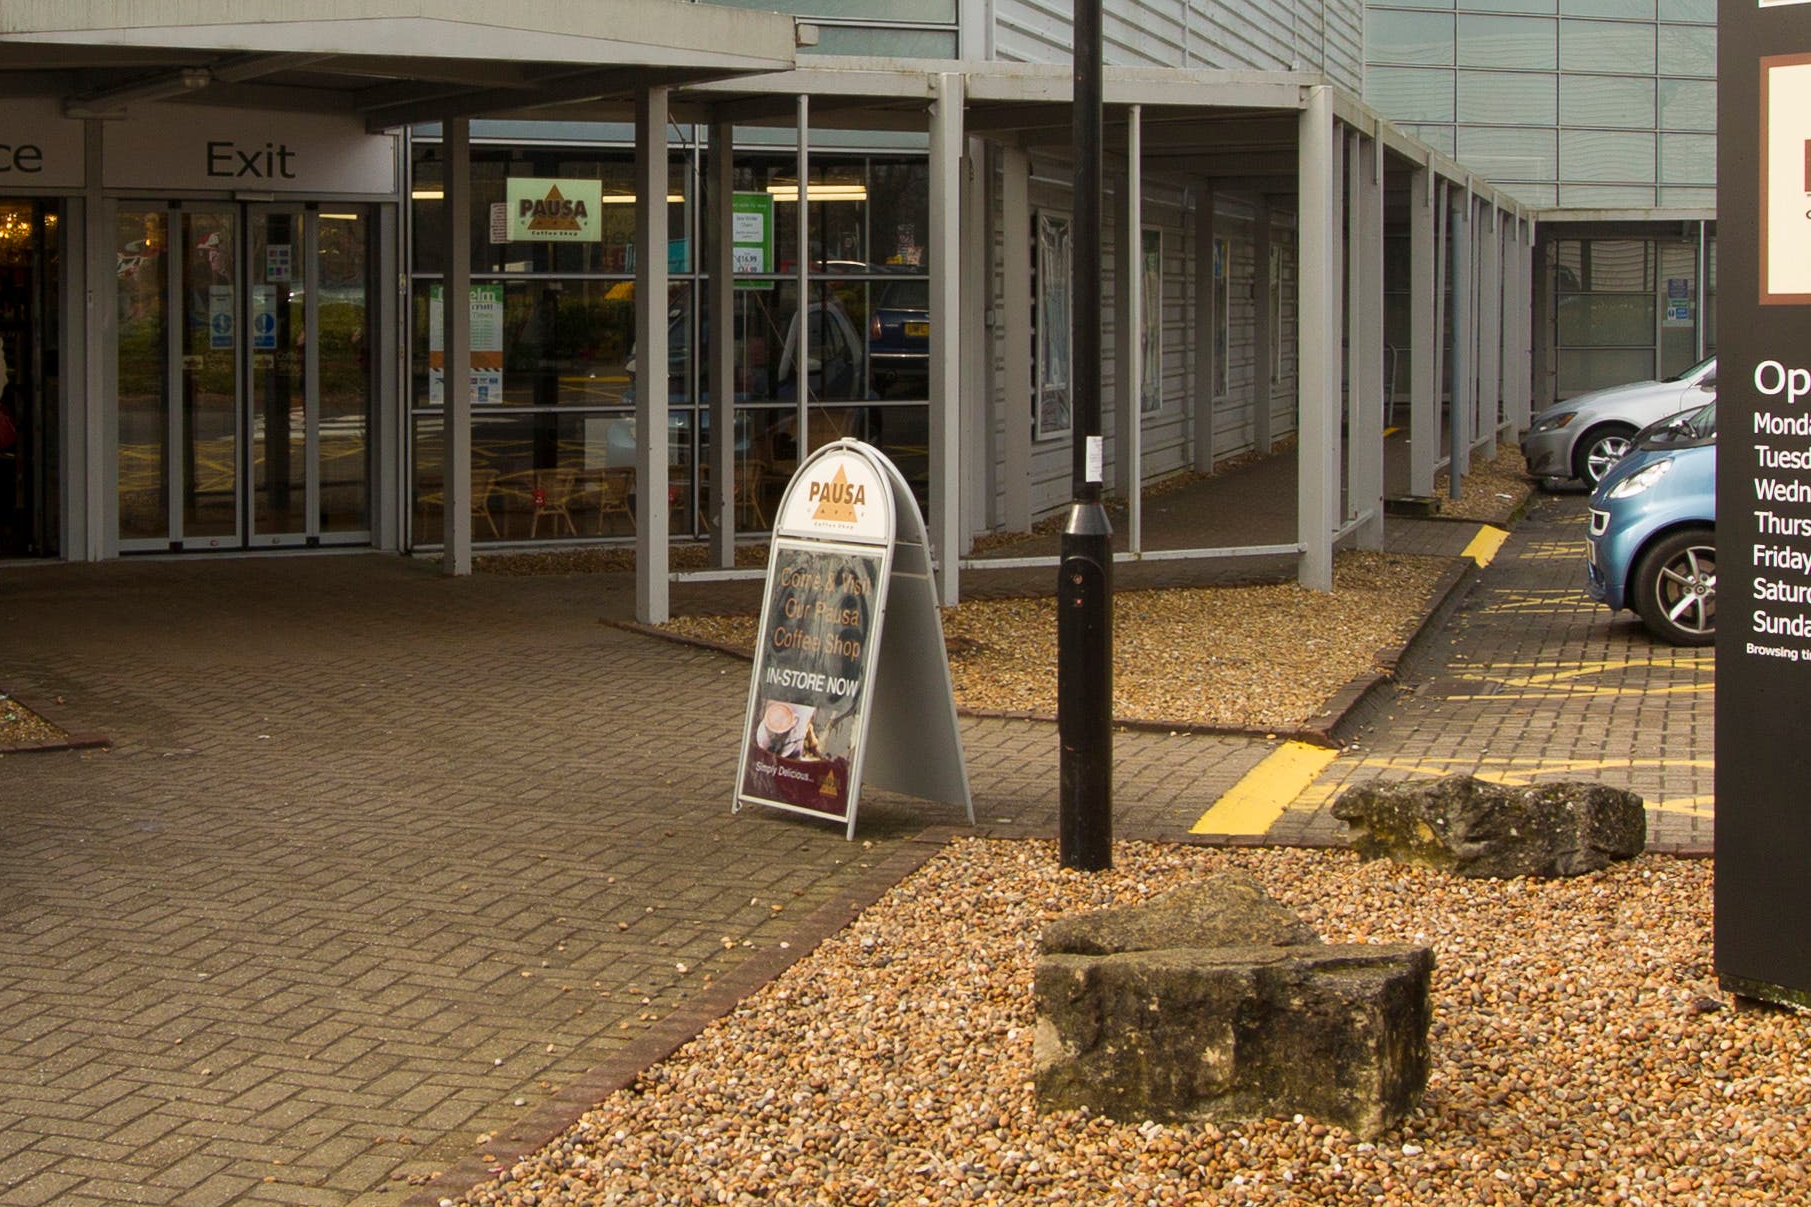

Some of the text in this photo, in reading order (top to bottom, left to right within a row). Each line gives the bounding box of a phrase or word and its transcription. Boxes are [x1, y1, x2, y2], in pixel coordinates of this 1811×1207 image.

[207, 141, 296, 178] Exit
[519, 199, 588, 218] PAUSA
[809, 481, 866, 506] PAUSA
[781, 566, 821, 590] Come
[825, 571, 836, 593] &
[785, 597, 860, 627] Our Pausa
[773, 625, 861, 662] Coffee Shop
[1746, 642, 1799, 662] Browsing
[766, 667, 859, 697] IN-STORE NOW
[755, 760, 777, 776] Simply
